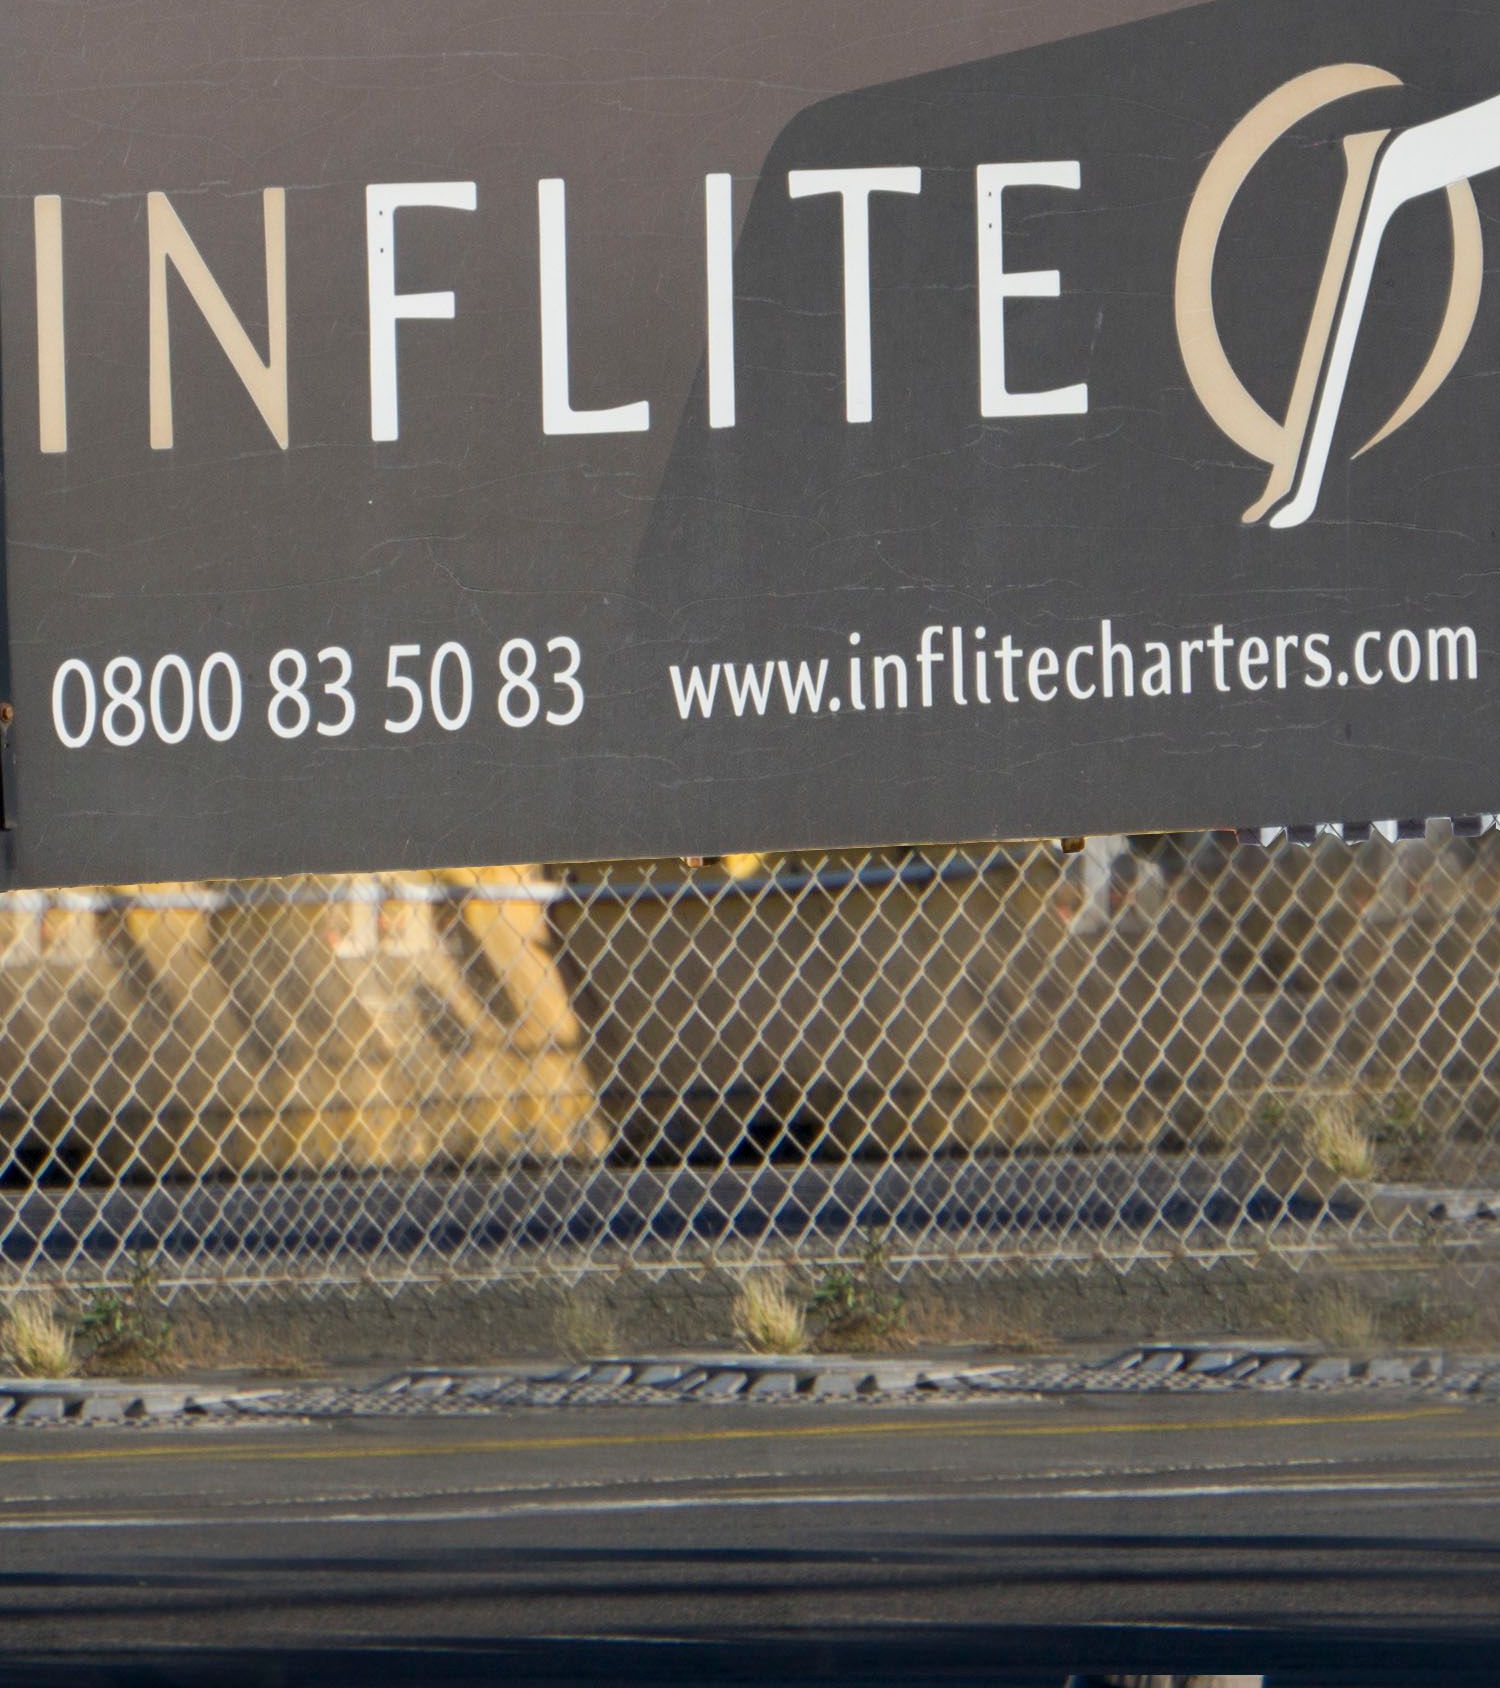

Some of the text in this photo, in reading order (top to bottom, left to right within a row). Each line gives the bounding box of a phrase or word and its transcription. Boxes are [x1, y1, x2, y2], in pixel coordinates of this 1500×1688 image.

[33, 160, 1088, 454] INFLITE
[52, 636, 584, 749] 0800 83 50 83
[669, 620, 1479, 719] www.inflitecharters.com
